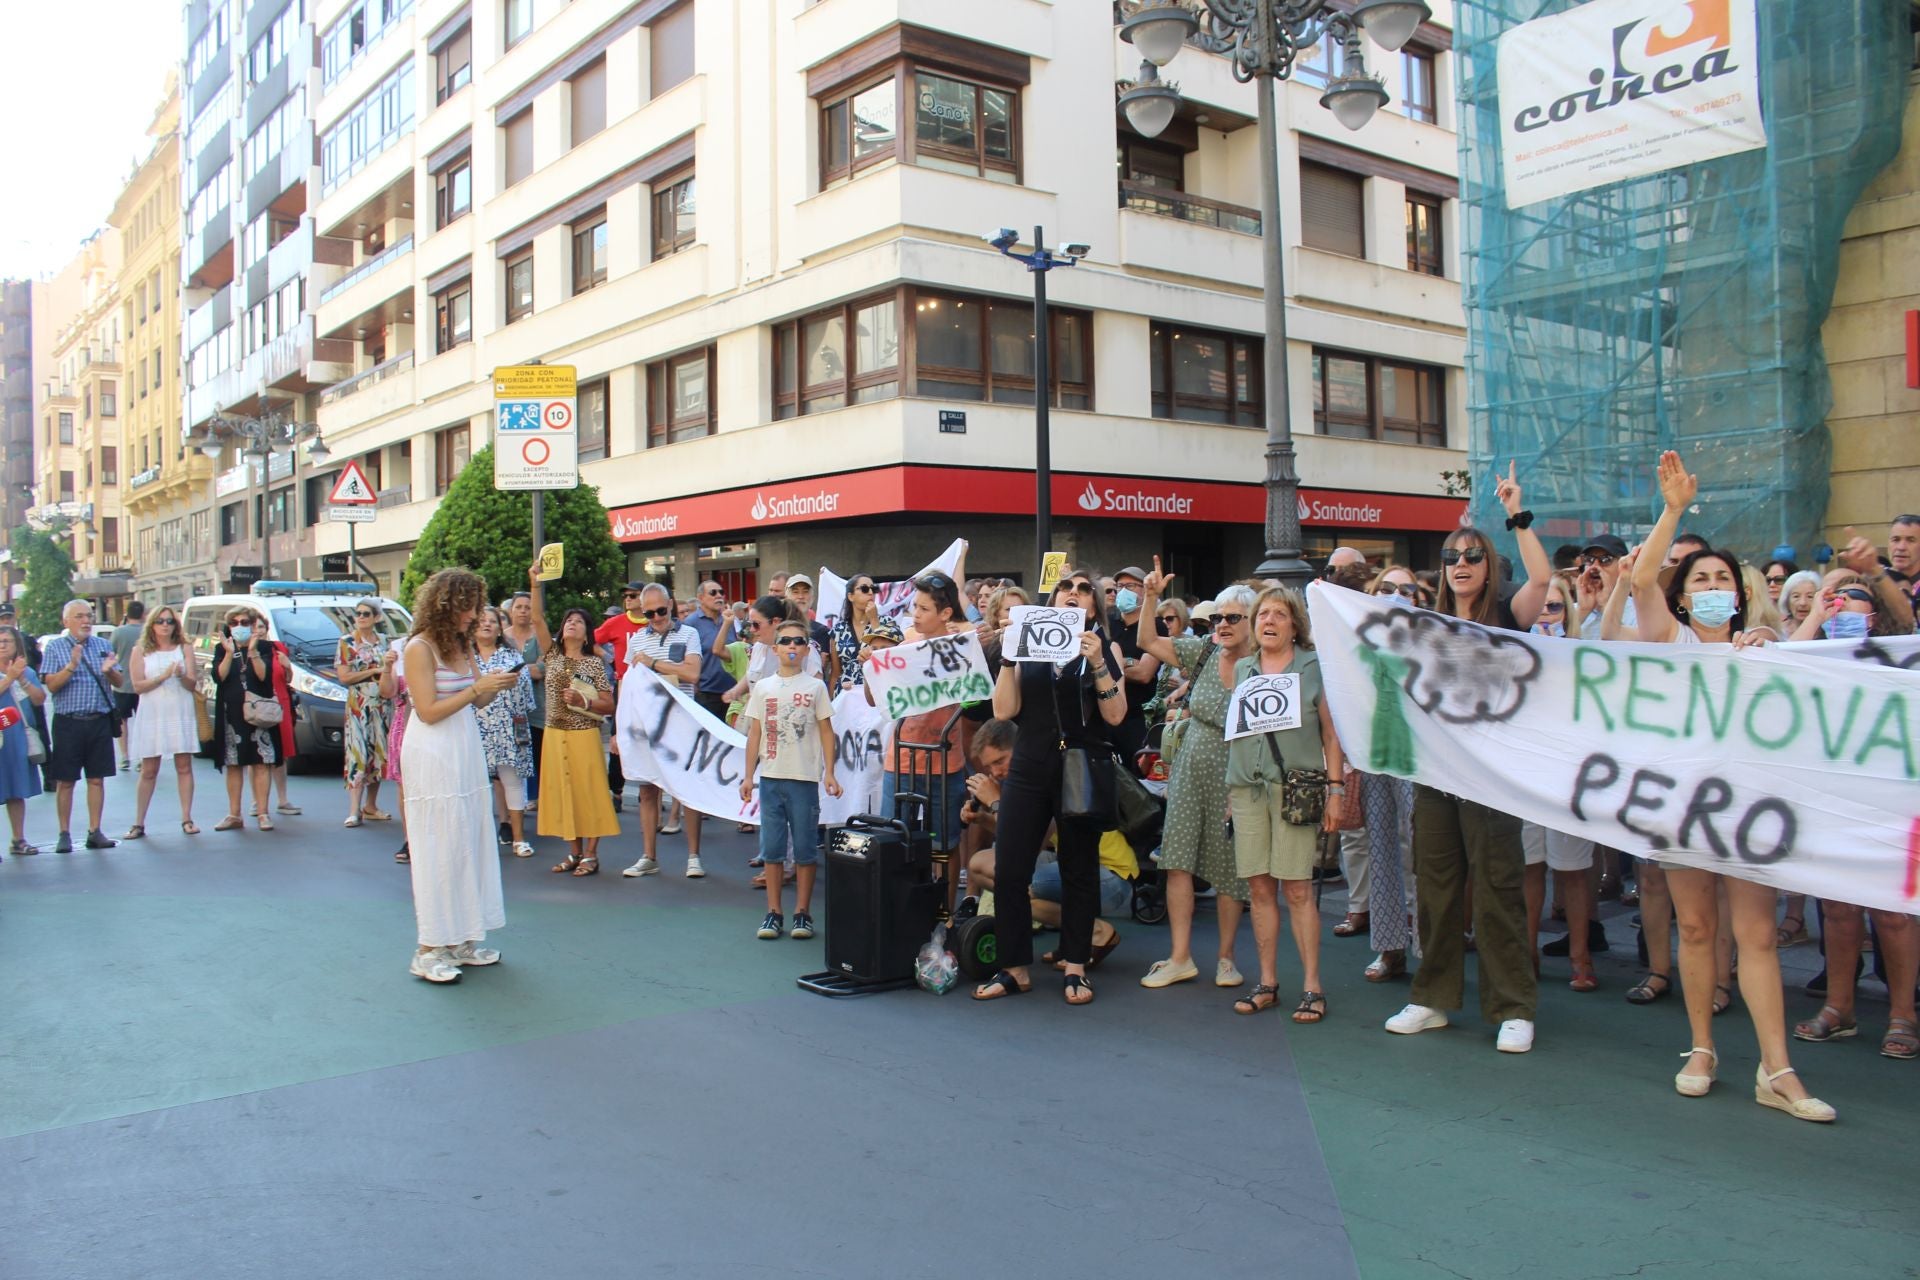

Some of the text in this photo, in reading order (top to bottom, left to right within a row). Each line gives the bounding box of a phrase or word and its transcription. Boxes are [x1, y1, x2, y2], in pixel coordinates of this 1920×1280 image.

[1514, 48, 1739, 133] coinca
[551, 411, 564, 420] 10
[769, 493, 839, 519] Santander
[1104, 489, 1193, 514] Santander
[1312, 500, 1382, 523] Santander
[626, 513, 678, 537] Santander
[1025, 625, 1067, 649] NO
[1241, 695, 1283, 718] NO
[1573, 646, 1917, 780] RENOVA
[1250, 716, 1293, 726] INCINERADORA
[1571, 752, 1798, 865] PERO
